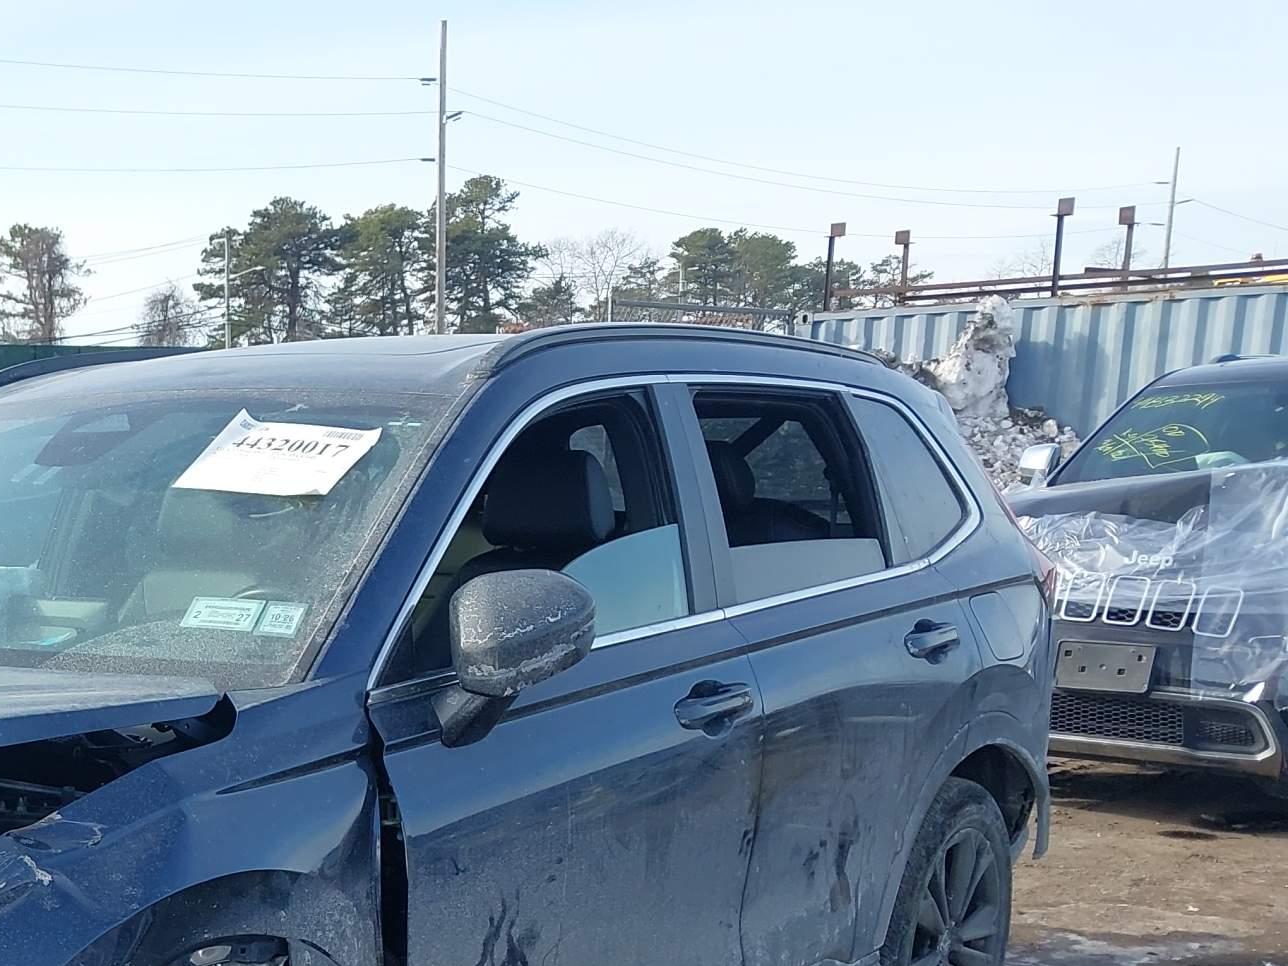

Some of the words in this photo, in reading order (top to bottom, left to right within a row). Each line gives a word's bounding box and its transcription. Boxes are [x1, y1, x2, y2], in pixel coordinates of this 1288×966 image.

[232, 435, 352, 457] 44320017
[1123, 550, 1174, 569] Jeep
[192, 610, 202, 619] 2
[235, 613, 251, 622] 27
